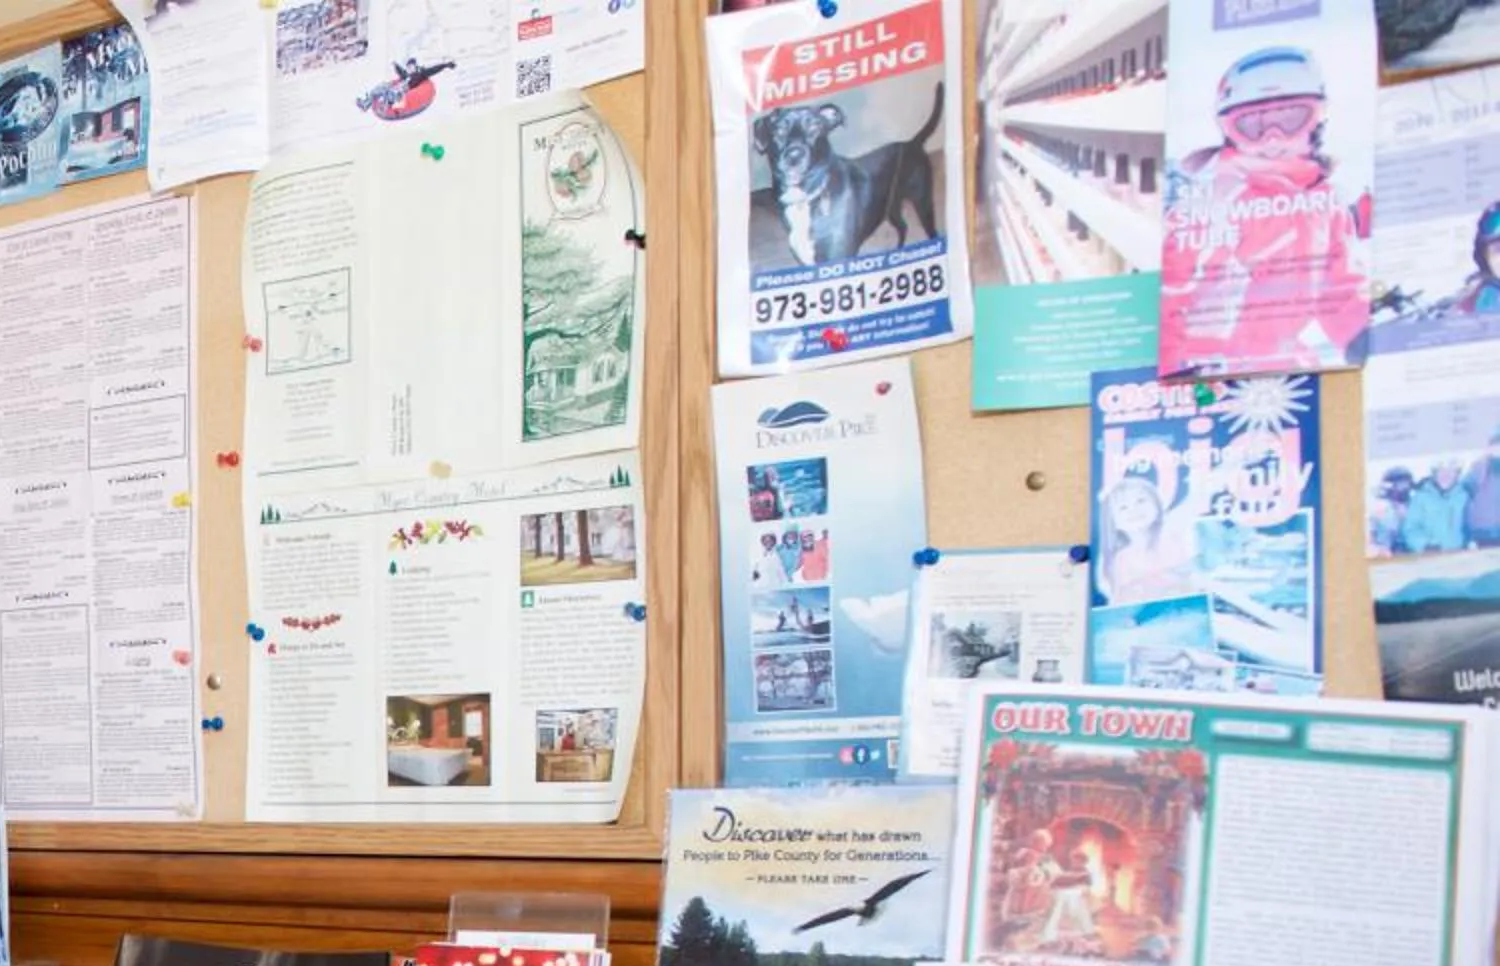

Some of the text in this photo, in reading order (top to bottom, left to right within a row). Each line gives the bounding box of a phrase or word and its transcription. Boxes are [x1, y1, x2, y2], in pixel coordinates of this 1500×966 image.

[793, 22, 897, 65] STILL
[763, 40, 928, 102] MISSING
[755, 272, 815, 288] Please
[819, 264, 845, 279] DO
[849, 256, 885, 272] NOT
[755, 264, 945, 323] 973-981-2988
[991, 702, 1195, 743] OUR TOWN
[703, 806, 922, 843] Discover what has drawn
[683, 850, 725, 864] People
[727, 851, 740, 861] to
[743, 850, 770, 861] Pike
[773, 850, 819, 864] County
[824, 850, 842, 861] for
